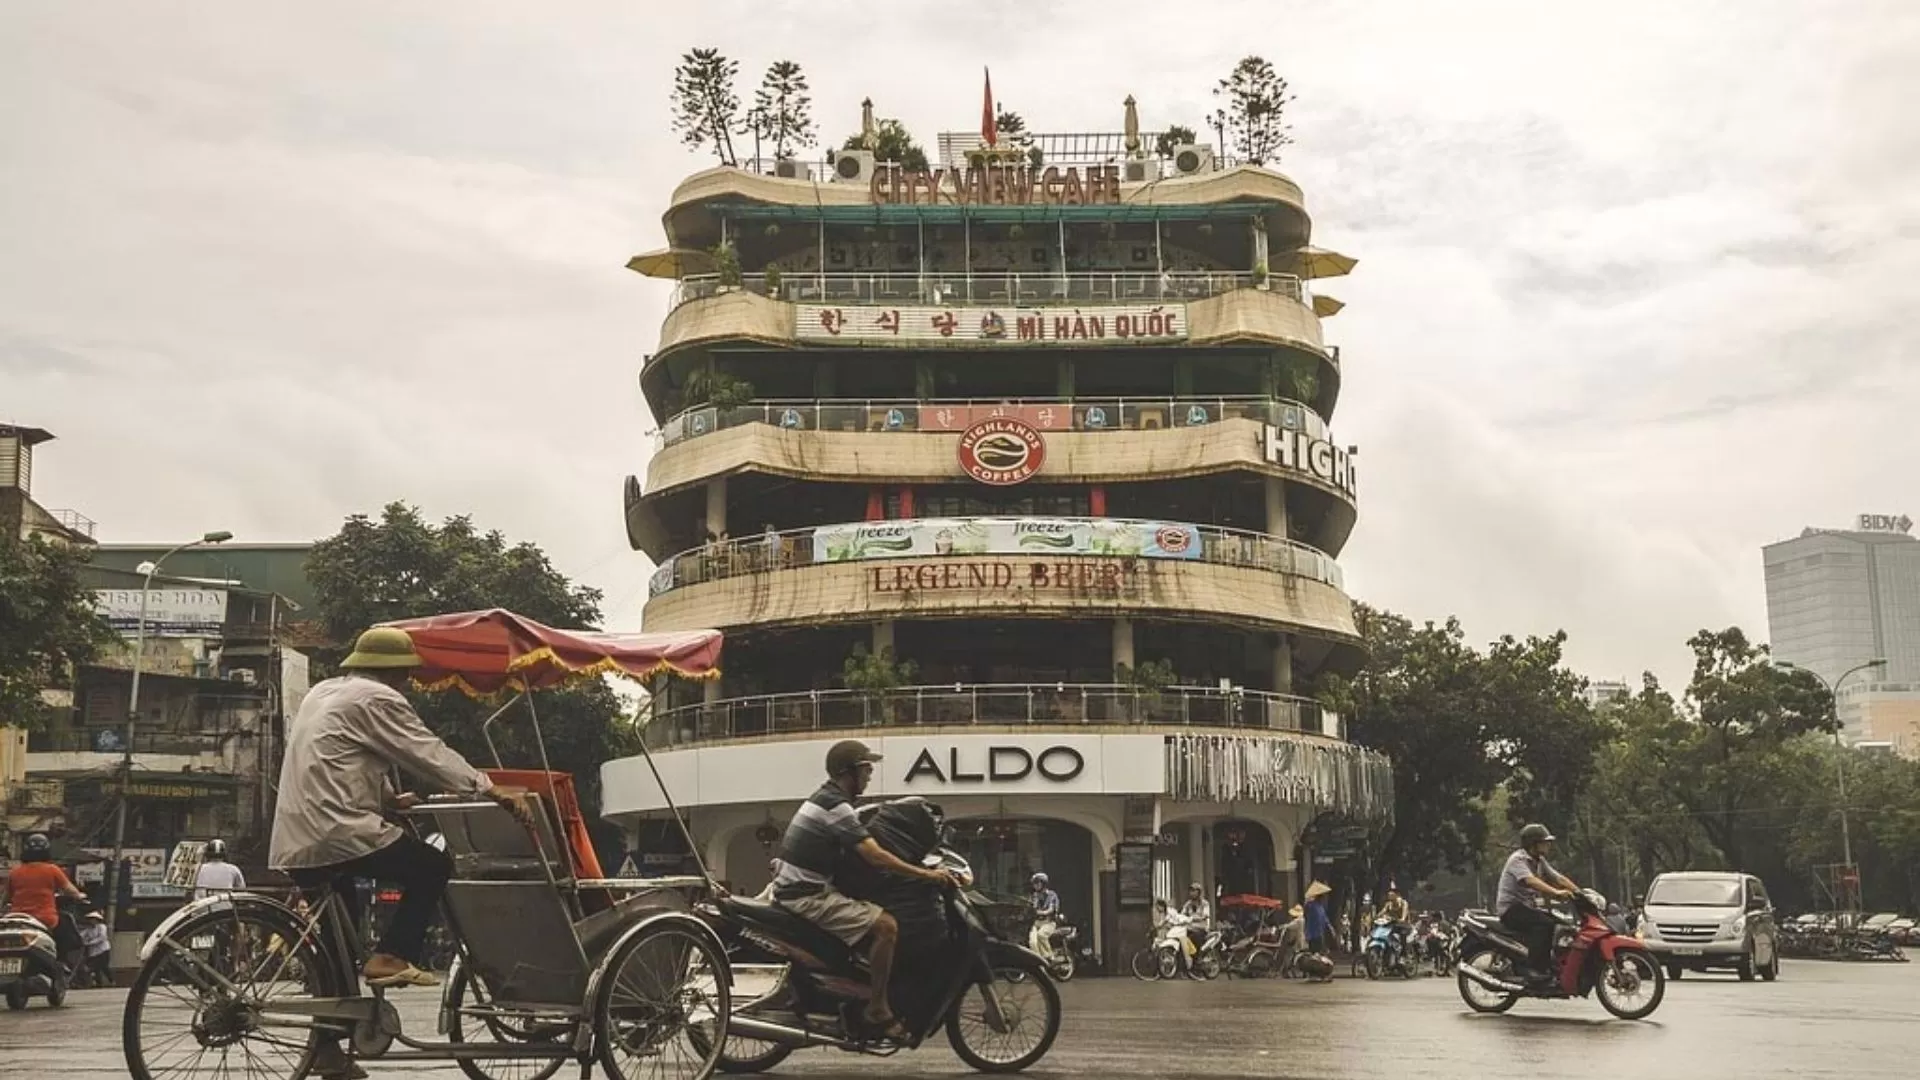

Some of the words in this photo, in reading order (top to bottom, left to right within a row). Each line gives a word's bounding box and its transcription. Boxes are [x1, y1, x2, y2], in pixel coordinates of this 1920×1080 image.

[870, 166, 943, 205] CITY
[951, 166, 1035, 205] VIEW
[1016, 310, 1045, 340] MÌ
[1055, 308, 1105, 339] HÀN
[1115, 305, 1177, 339] QUỐC
[961, 422, 1042, 449] HIGHLANDS
[971, 465, 1033, 482] COFFEE
[1860, 514, 1897, 531] BIDV
[874, 562, 1011, 593] LEGEND
[904, 745, 1085, 783] ALDO
